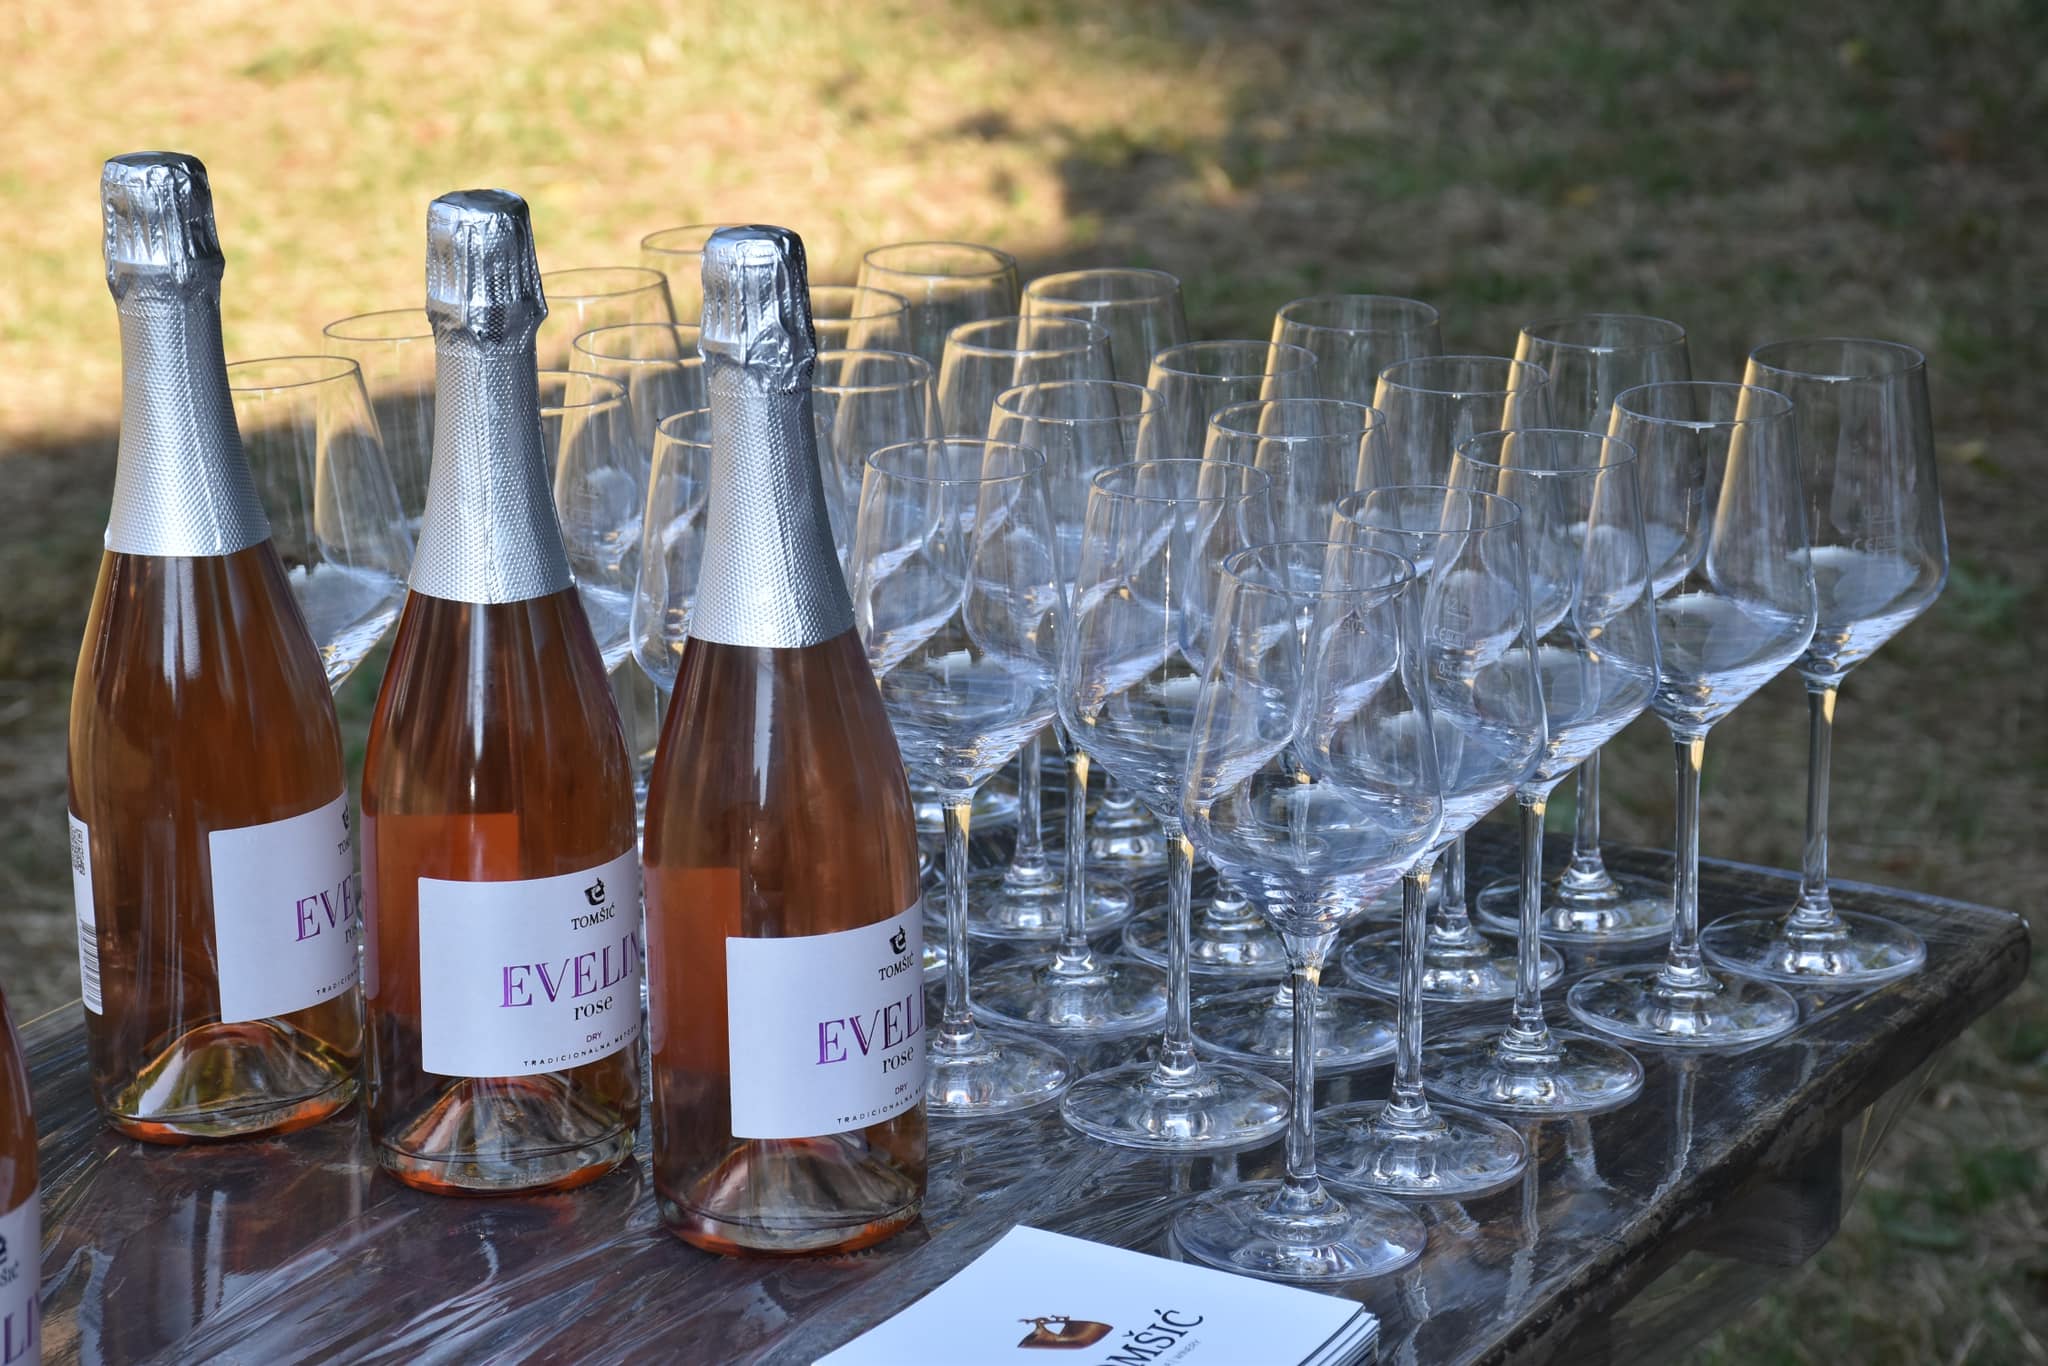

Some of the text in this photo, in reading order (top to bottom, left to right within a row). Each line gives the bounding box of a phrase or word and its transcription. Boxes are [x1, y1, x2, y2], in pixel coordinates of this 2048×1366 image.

[571, 902, 615, 930] TOMŠIĆ
[878, 951, 914, 981] TOMŠIĆ
[574, 996, 613, 1020] rose
[586, 1032, 602, 1043] DRY
[524, 1043, 610, 1066] TRADICIONALNA
[882, 1046, 914, 1073] rose
[895, 1082, 908, 1095] DRY
[837, 1093, 912, 1124] TRADICIONALNA
[1097, 1309, 1203, 1366] MŠIĆ
